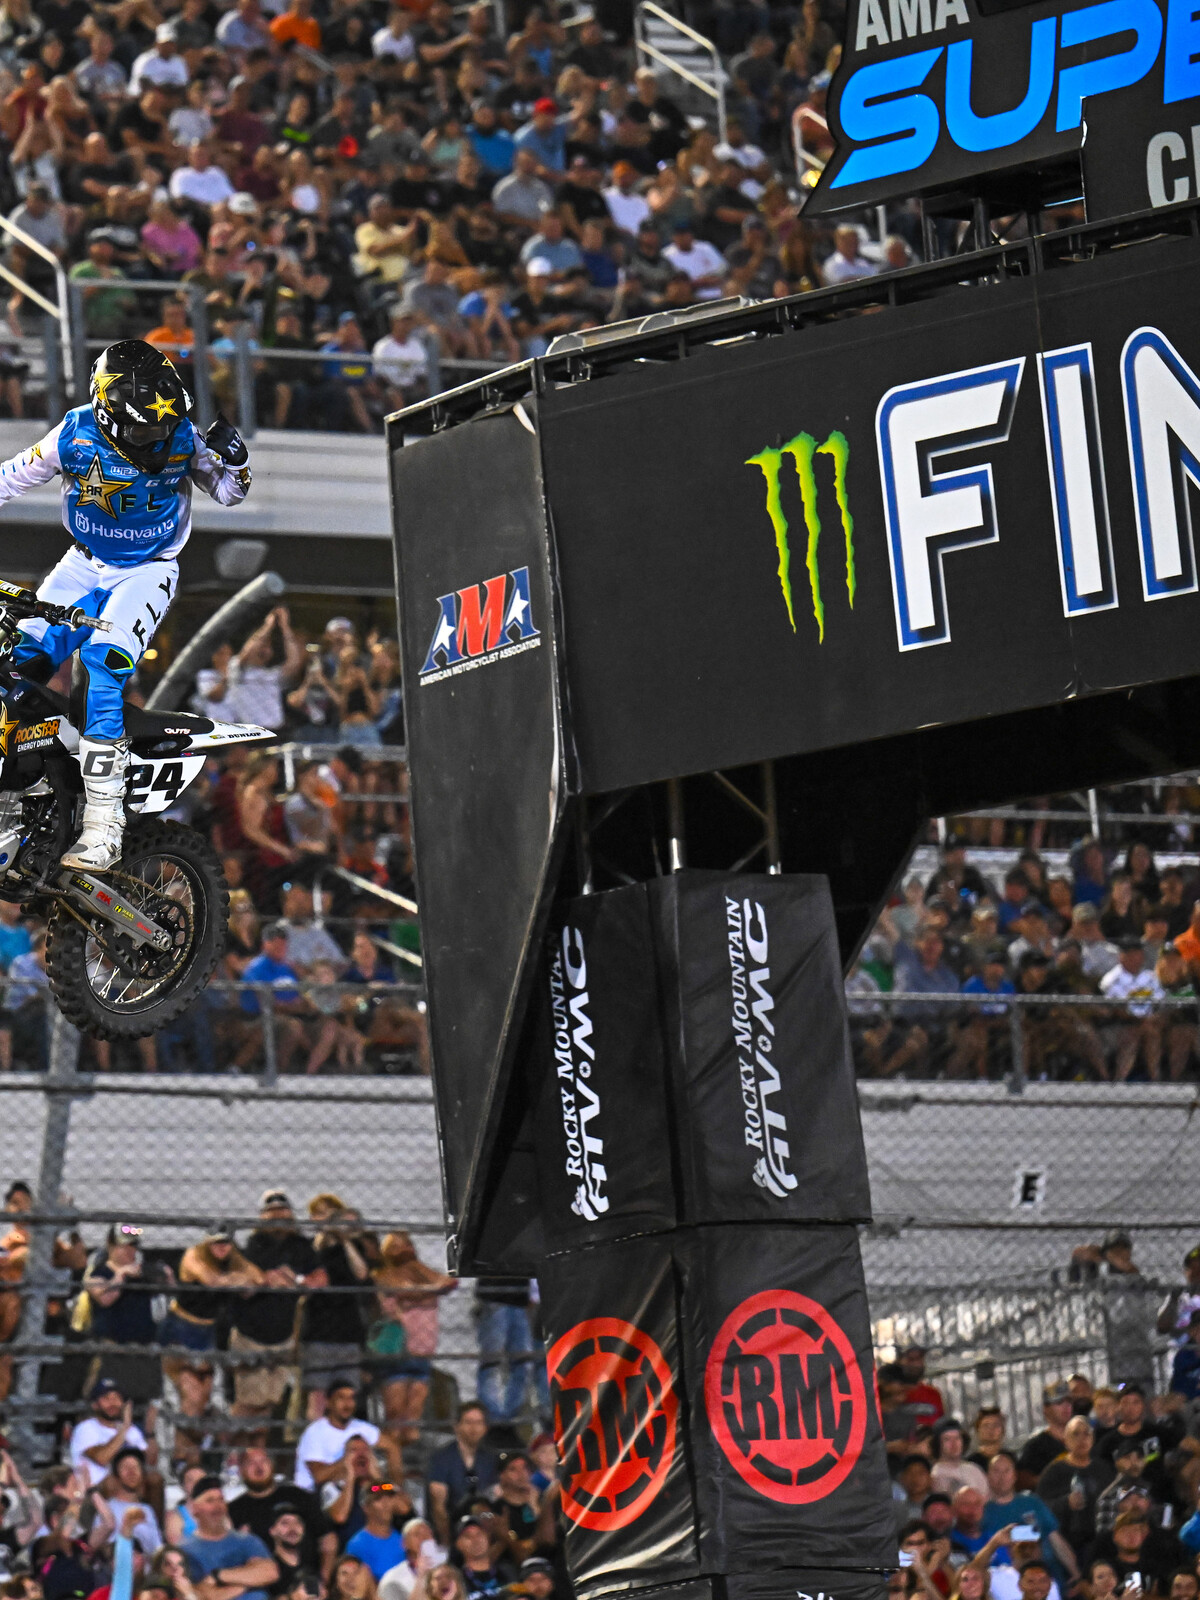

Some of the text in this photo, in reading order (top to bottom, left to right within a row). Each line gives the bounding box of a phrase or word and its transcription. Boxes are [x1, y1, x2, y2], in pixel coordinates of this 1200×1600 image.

[855, 0, 970, 50] AMA
[1146, 124, 1200, 208] C
[119, 489, 175, 514] FL
[91, 518, 175, 541] Husqvarna
[132, 575, 172, 648] FLY
[418, 566, 541, 675] AMA
[420, 638, 541, 687] AMERICAN MOTORCYCLIST ASSOCIATION
[14, 718, 61, 744] ROCKSTAR
[17, 737, 54, 753] ENERGY DRINK
[227, 731, 262, 739] DUNLOP
[124, 761, 186, 804] 24
[725, 896, 764, 1151] ROCKY MOUNTAIN
[561, 1087, 584, 1178] ROCKY
[725, 1352, 847, 1442] RM
[553, 1373, 658, 1473] RM
